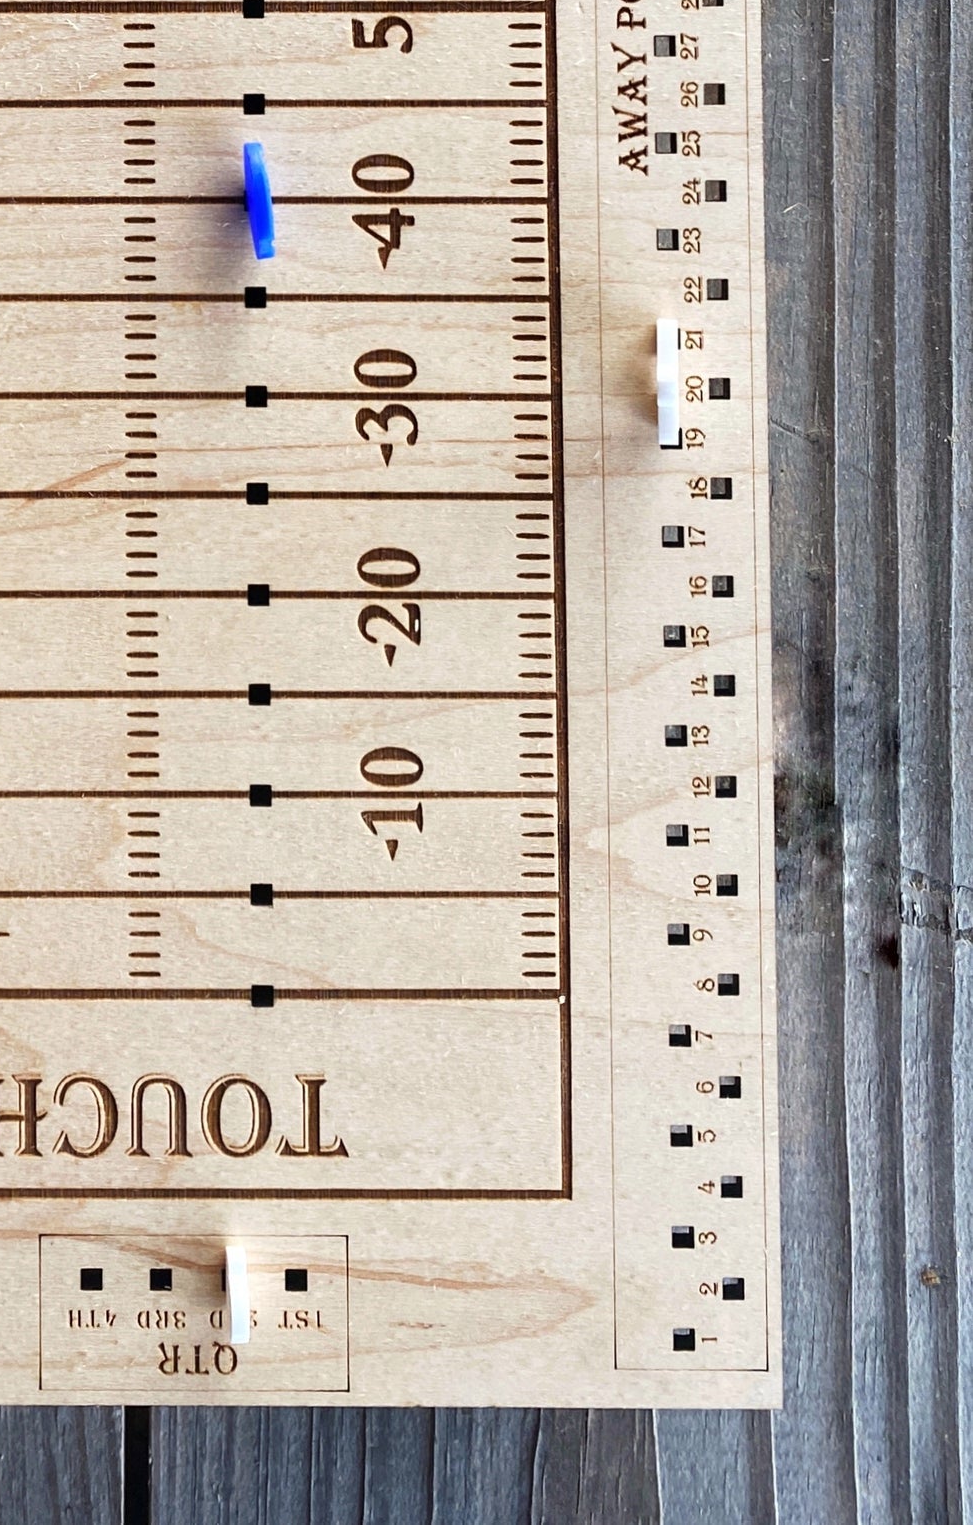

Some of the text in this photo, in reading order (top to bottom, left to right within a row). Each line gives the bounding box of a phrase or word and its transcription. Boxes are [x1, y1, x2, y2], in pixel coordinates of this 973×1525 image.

[679, 32, 700, 61] 27
[679, 80, 700, 109] 26
[608, 41, 649, 177] AWAY
[680, 129, 702, 158] 25
[351, 153, 416, 250] 40
[681, 177, 702, 206] 24
[682, 226, 702, 255] 23
[682, 275, 703, 305] 22
[684, 329, 704, 351] 21
[353, 348, 420, 447] 30
[684, 375, 705, 404] 20
[684, 427, 707, 451] 19
[685, 476, 706, 501] 18
[687, 525, 707, 548] 17
[356, 546, 422, 647] 20
[688, 574, 709, 599] 16
[689, 624, 711, 649] 15
[690, 673, 709, 697] 14
[690, 724, 711, 748] 13
[359, 745, 425, 837] 10
[691, 775, 712, 799] 12
[692, 826, 711, 845] 11
[692, 873, 713, 897] 10
[691, 928, 714, 942] 9
[692, 977, 716, 993] 8
[694, 1029, 714, 1043] 7
[695, 1080, 716, 1095] 6
[696, 1128, 717, 1144] 5
[697, 1179, 716, 1195] 4
[697, 1230, 718, 1245] 3
[698, 1282, 719, 1297] 2
[68, 1309, 117, 1328] 4TH
[137, 1310, 186, 1329] 3RD
[278, 1310, 323, 1328] 1ST
[157, 1341, 238, 1375] QTR
